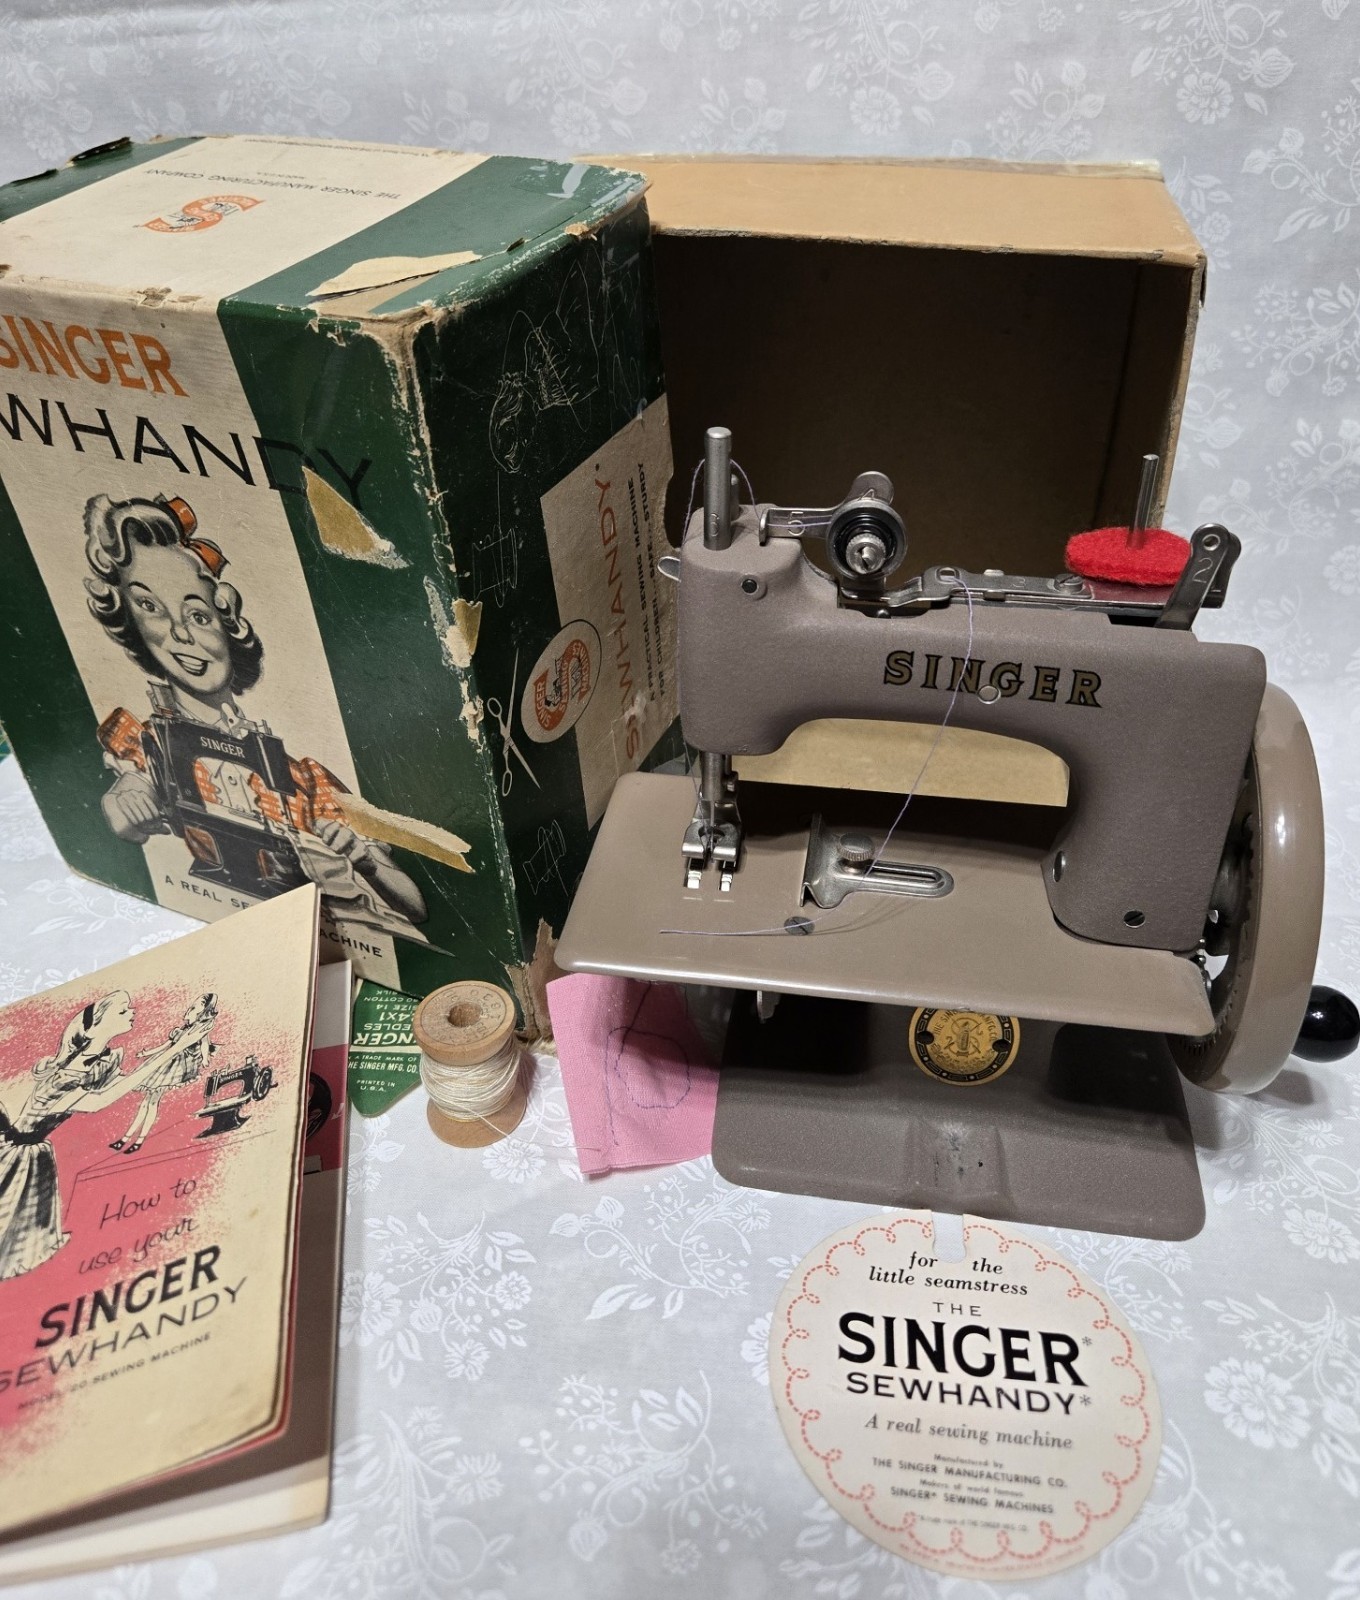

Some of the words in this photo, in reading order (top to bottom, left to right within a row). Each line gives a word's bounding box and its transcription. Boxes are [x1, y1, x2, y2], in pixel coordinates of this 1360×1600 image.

[143, 168, 204, 179] COMPANY
[208, 174, 317, 190] MANUFACTURING
[320, 185, 372, 197] SINGER
[373, 191, 401, 200] THE
[638, 463, 650, 522] STURDY
[628, 477, 640, 548] MACHINE
[787, 511, 806, 536] 5
[637, 554, 646, 610] SEWING
[1192, 557, 1213, 584] 2
[642, 614, 653, 689] PRACTICAL
[883, 650, 1103, 708] SINGER
[536, 681, 552, 727] SINGER
[200, 736, 246, 759] SINGER
[165, 874, 174, 886] A
[180, 880, 223, 903] REAL
[319, 927, 383, 958] ACHINE
[363, 1023, 411, 1031] EDLES
[379, 1012, 414, 1022] 4X1
[353, 1032, 417, 1045] NGER
[348, 1061, 358, 1069] HE
[359, 1061, 386, 1071] SINGER
[387, 1062, 405, 1072] MFG.
[406, 1064, 419, 1074] CO.
[100, 1194, 161, 1229] How
[170, 1177, 197, 1200] to
[78, 1246, 124, 1275] use
[133, 1217, 200, 1263] your
[908, 1251, 938, 1270] for
[972, 1257, 1003, 1275] the
[868, 1266, 915, 1286] little
[924, 1275, 1028, 1296] seamstress
[35, 1245, 221, 1349] SINGER
[932, 1302, 982, 1317] THE
[0, 1276, 248, 1393] SEWHANDY
[92, 1358, 146, 1385] SEWING
[151, 1331, 211, 1362] MACHINE
[864, 1413, 879, 1430] A
[886, 1418, 921, 1434] real
[928, 1423, 988, 1445] sewing
[995, 1430, 1073, 1450] machine
[872, 1456, 893, 1468] THE
[898, 1459, 937, 1474] SINGER
[944, 1465, 1041, 1485] MANUFACTURING
[1047, 1477, 1068, 1488] CO.
[943, 1492, 988, 1507] SEWING
[995, 1499, 1054, 1514] MACHINES
